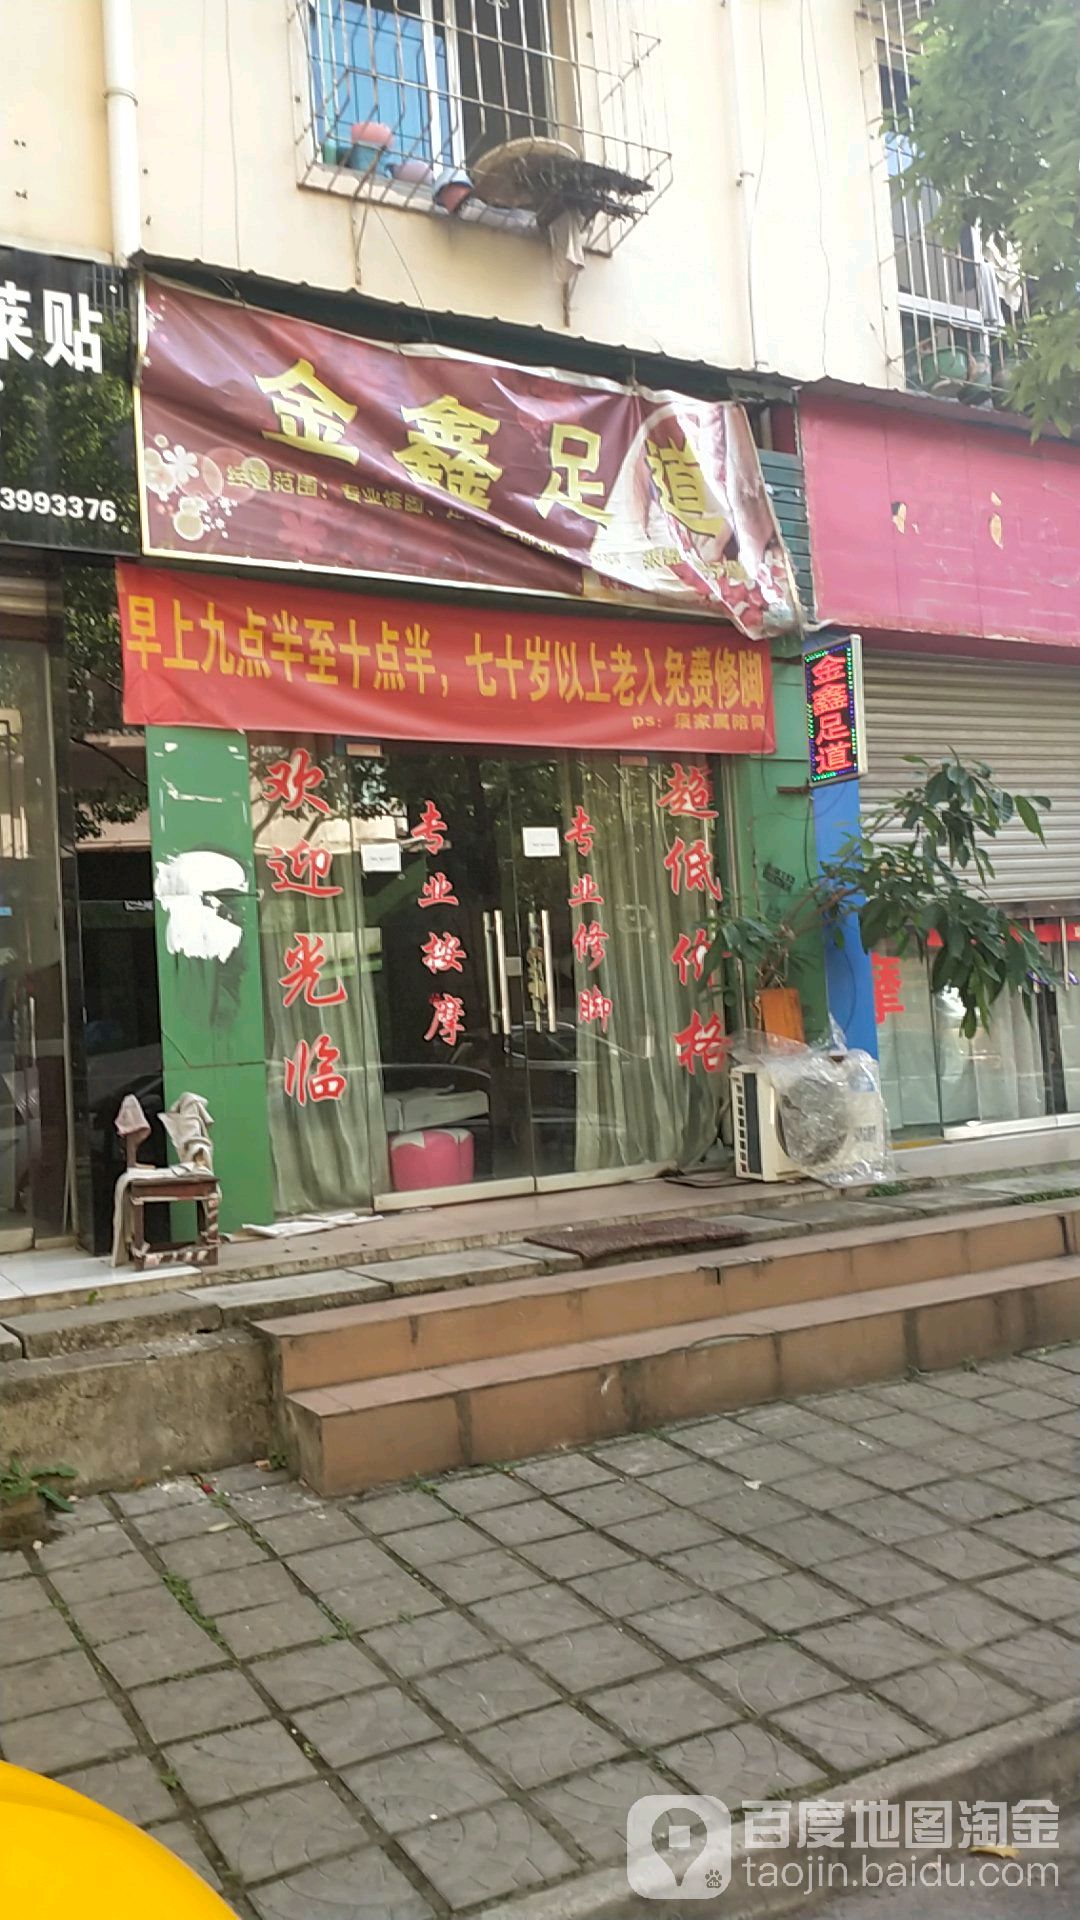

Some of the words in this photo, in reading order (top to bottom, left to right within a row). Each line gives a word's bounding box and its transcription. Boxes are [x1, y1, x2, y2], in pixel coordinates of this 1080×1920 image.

[0, 487, 117, 522] 3993376
[254, 359, 725, 538] 金鑫足道
[811, 654, 852, 774] 金鑫足道
[261, 748, 349, 1107] 欢迎光临
[410, 800, 467, 1046] 专业按摩
[564, 806, 614, 1033] 专业修脚
[657, 763, 732, 1075] 超低价格
